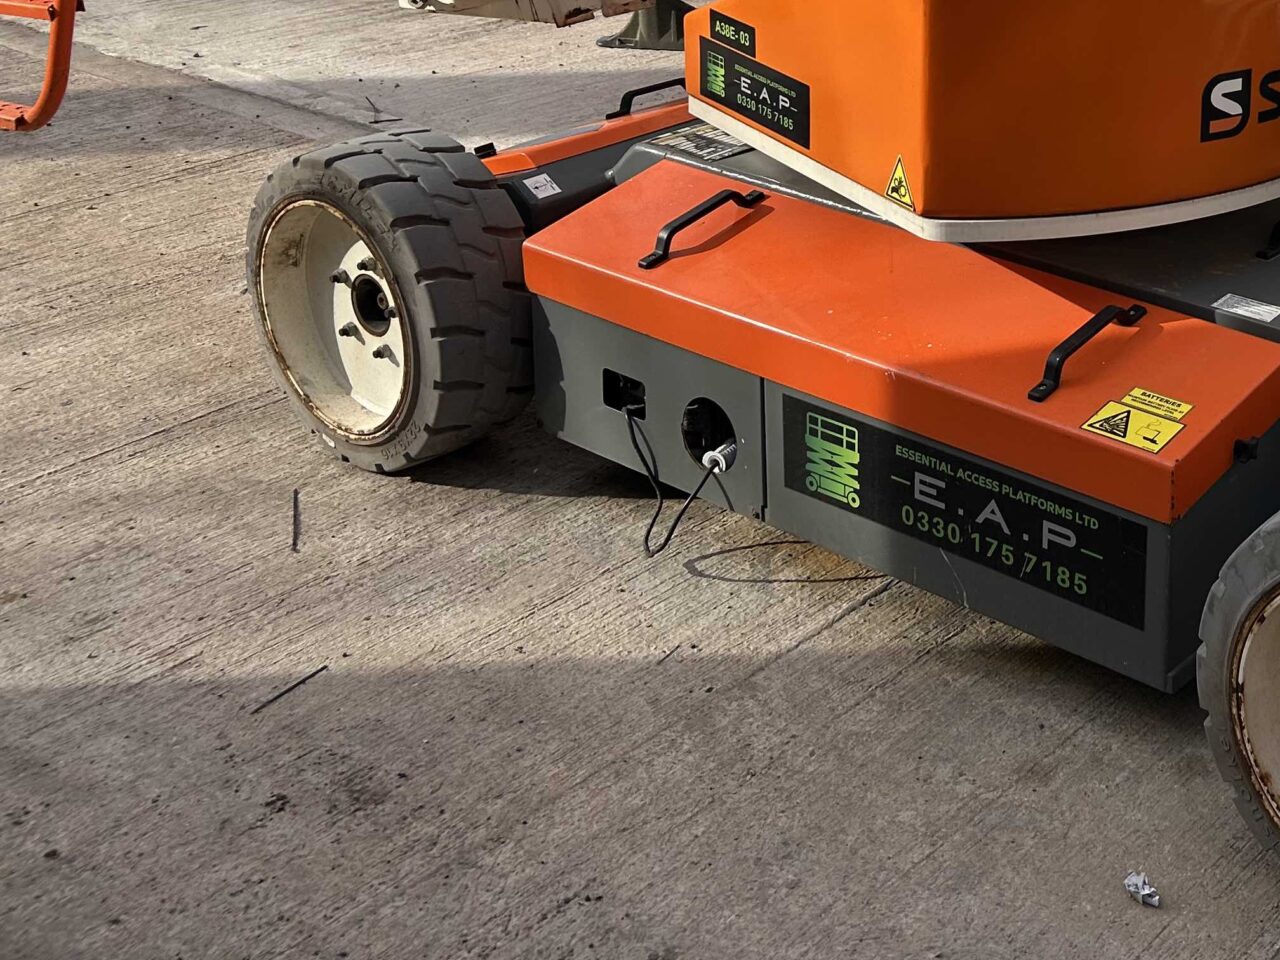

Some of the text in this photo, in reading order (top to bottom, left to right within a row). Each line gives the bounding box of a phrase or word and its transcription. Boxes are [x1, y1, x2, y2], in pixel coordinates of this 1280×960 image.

[737, 93, 794, 131] 0330 175 7185
[1140, 391, 1183, 408] BATTERIES
[895, 444, 1100, 530] ESSENTIAL ACCESS PLATFORMS LTD
[901, 504, 1089, 596] 0330 175 7185
